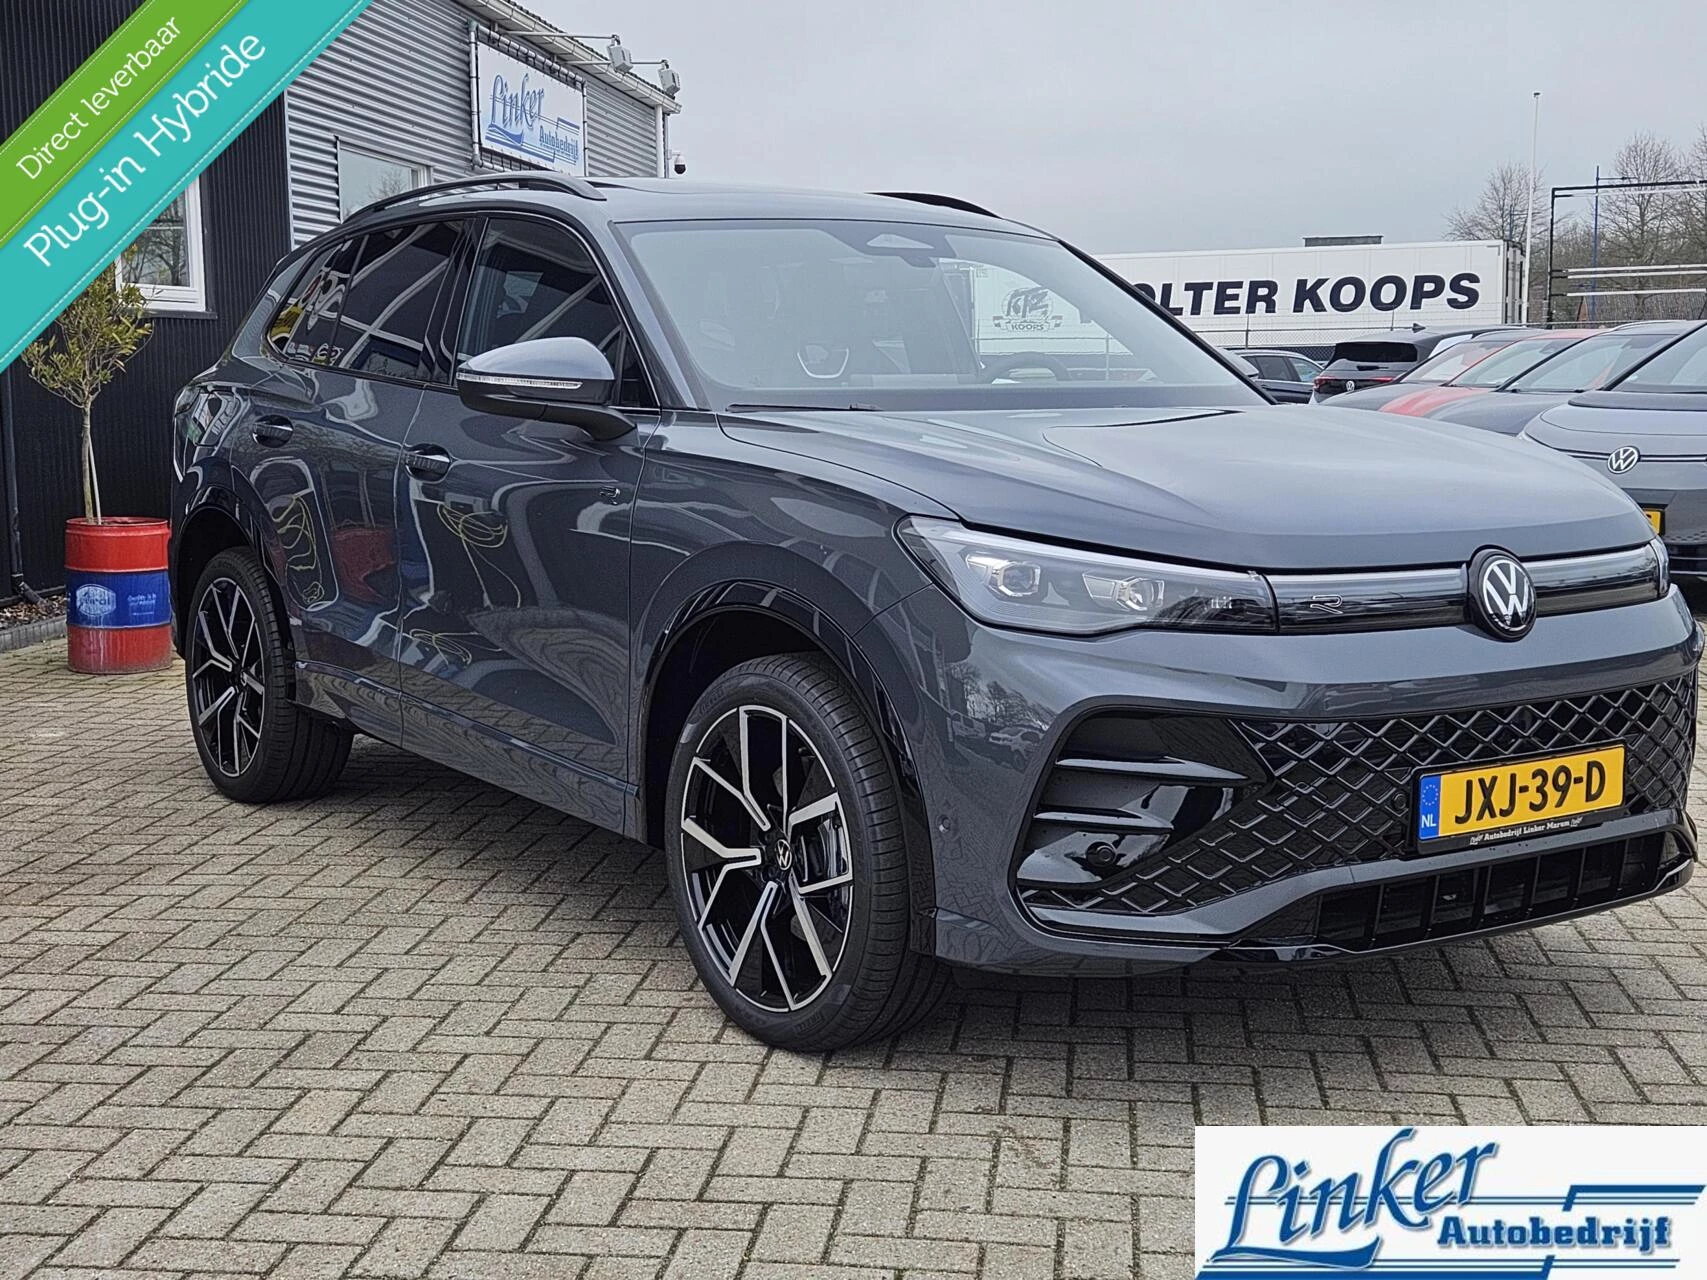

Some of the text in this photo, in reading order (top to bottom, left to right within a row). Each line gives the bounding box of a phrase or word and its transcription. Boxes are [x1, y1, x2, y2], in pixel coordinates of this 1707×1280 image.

[488, 73, 545, 146] Linker
[539, 125, 580, 161] Autobedrijf
[1133, 272, 1481, 316] LTER KOOPS
[1011, 323, 1045, 331] KOOPS
[1455, 760, 1606, 825] JXJ-39-D
[1421, 814, 1437, 828] NL
[1484, 827, 1522, 841] Autobedrijf
